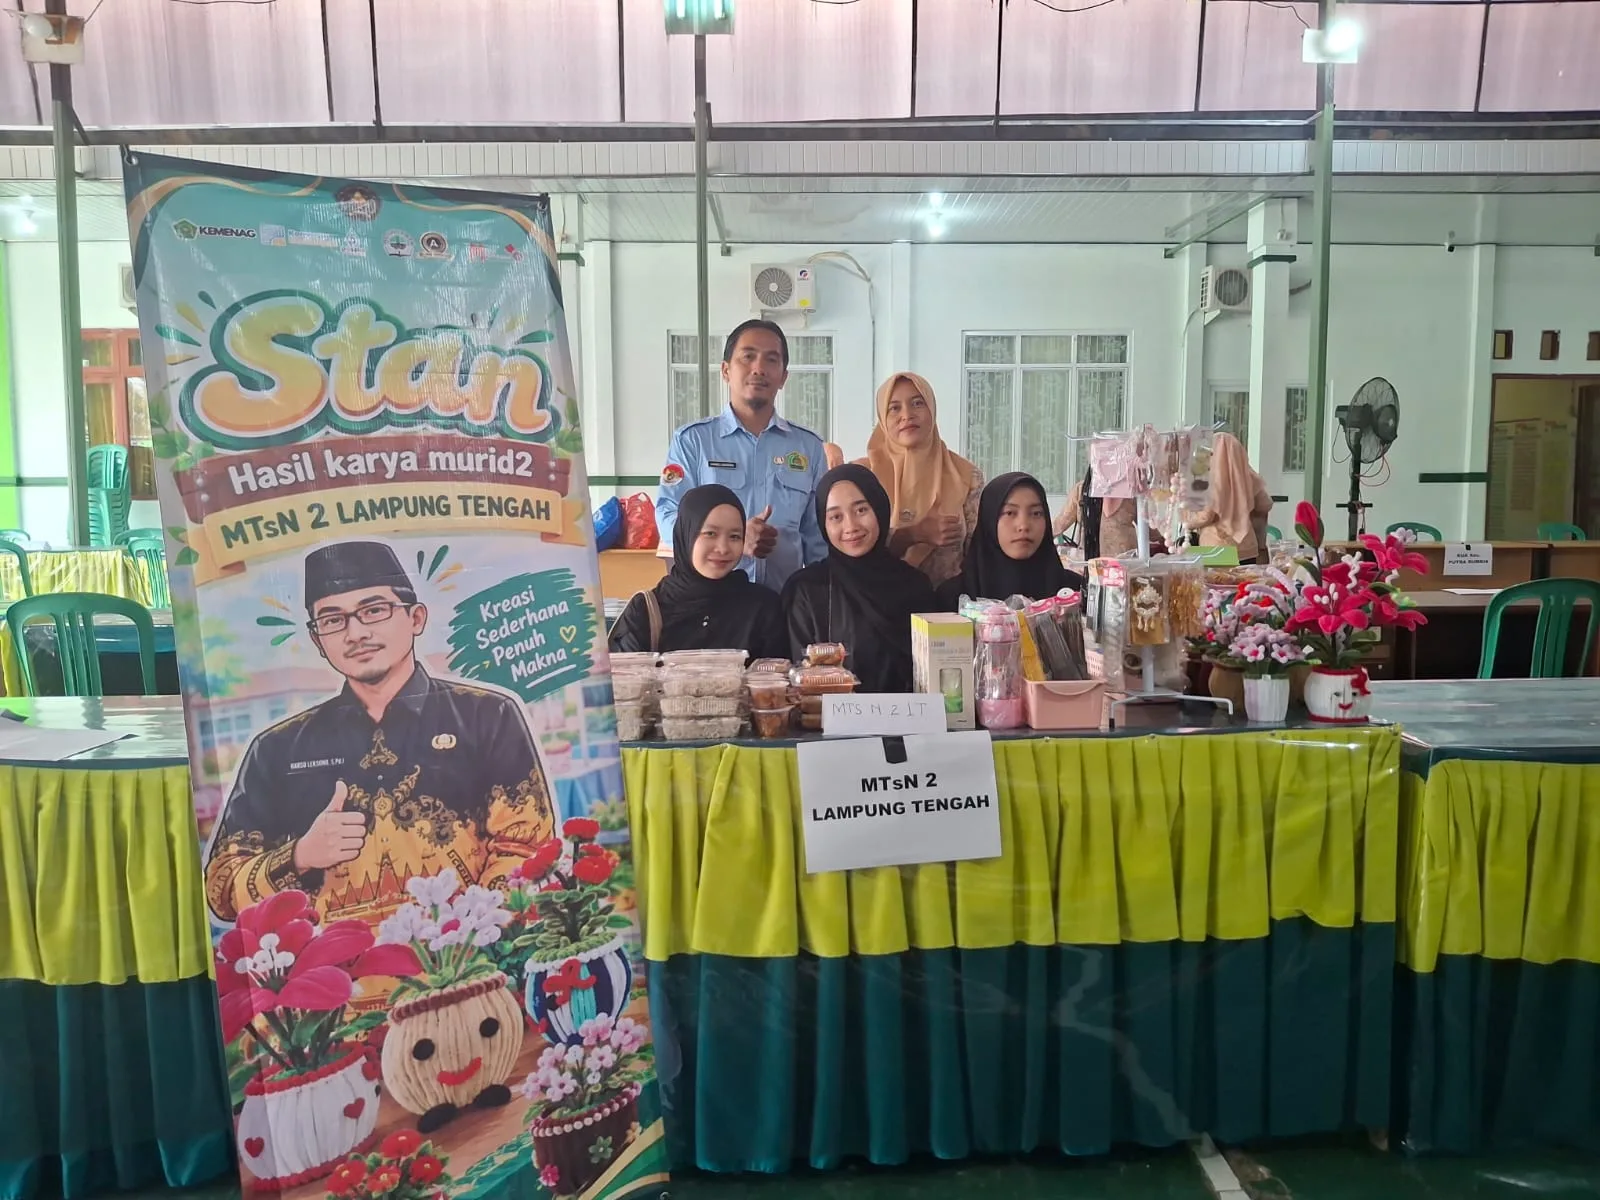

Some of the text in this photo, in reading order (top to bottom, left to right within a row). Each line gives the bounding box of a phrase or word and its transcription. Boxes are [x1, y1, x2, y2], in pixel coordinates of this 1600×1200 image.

[199, 226, 257, 238] KEMENAG
[194, 296, 553, 436] Stan
[228, 448, 534, 496] Hasil karya murid2
[220, 494, 552, 549] MTsN 2 LAMPUNG TENGAH
[479, 586, 536, 622] Kreasi
[475, 601, 569, 650] Sederhana
[492, 630, 546, 667] Penuh
[510, 648, 567, 682] Makna
[890, 704, 900, 716] 2
[861, 772, 938, 792] MTsN 2
[812, 795, 990, 822] LAMPUNG TENGAH
